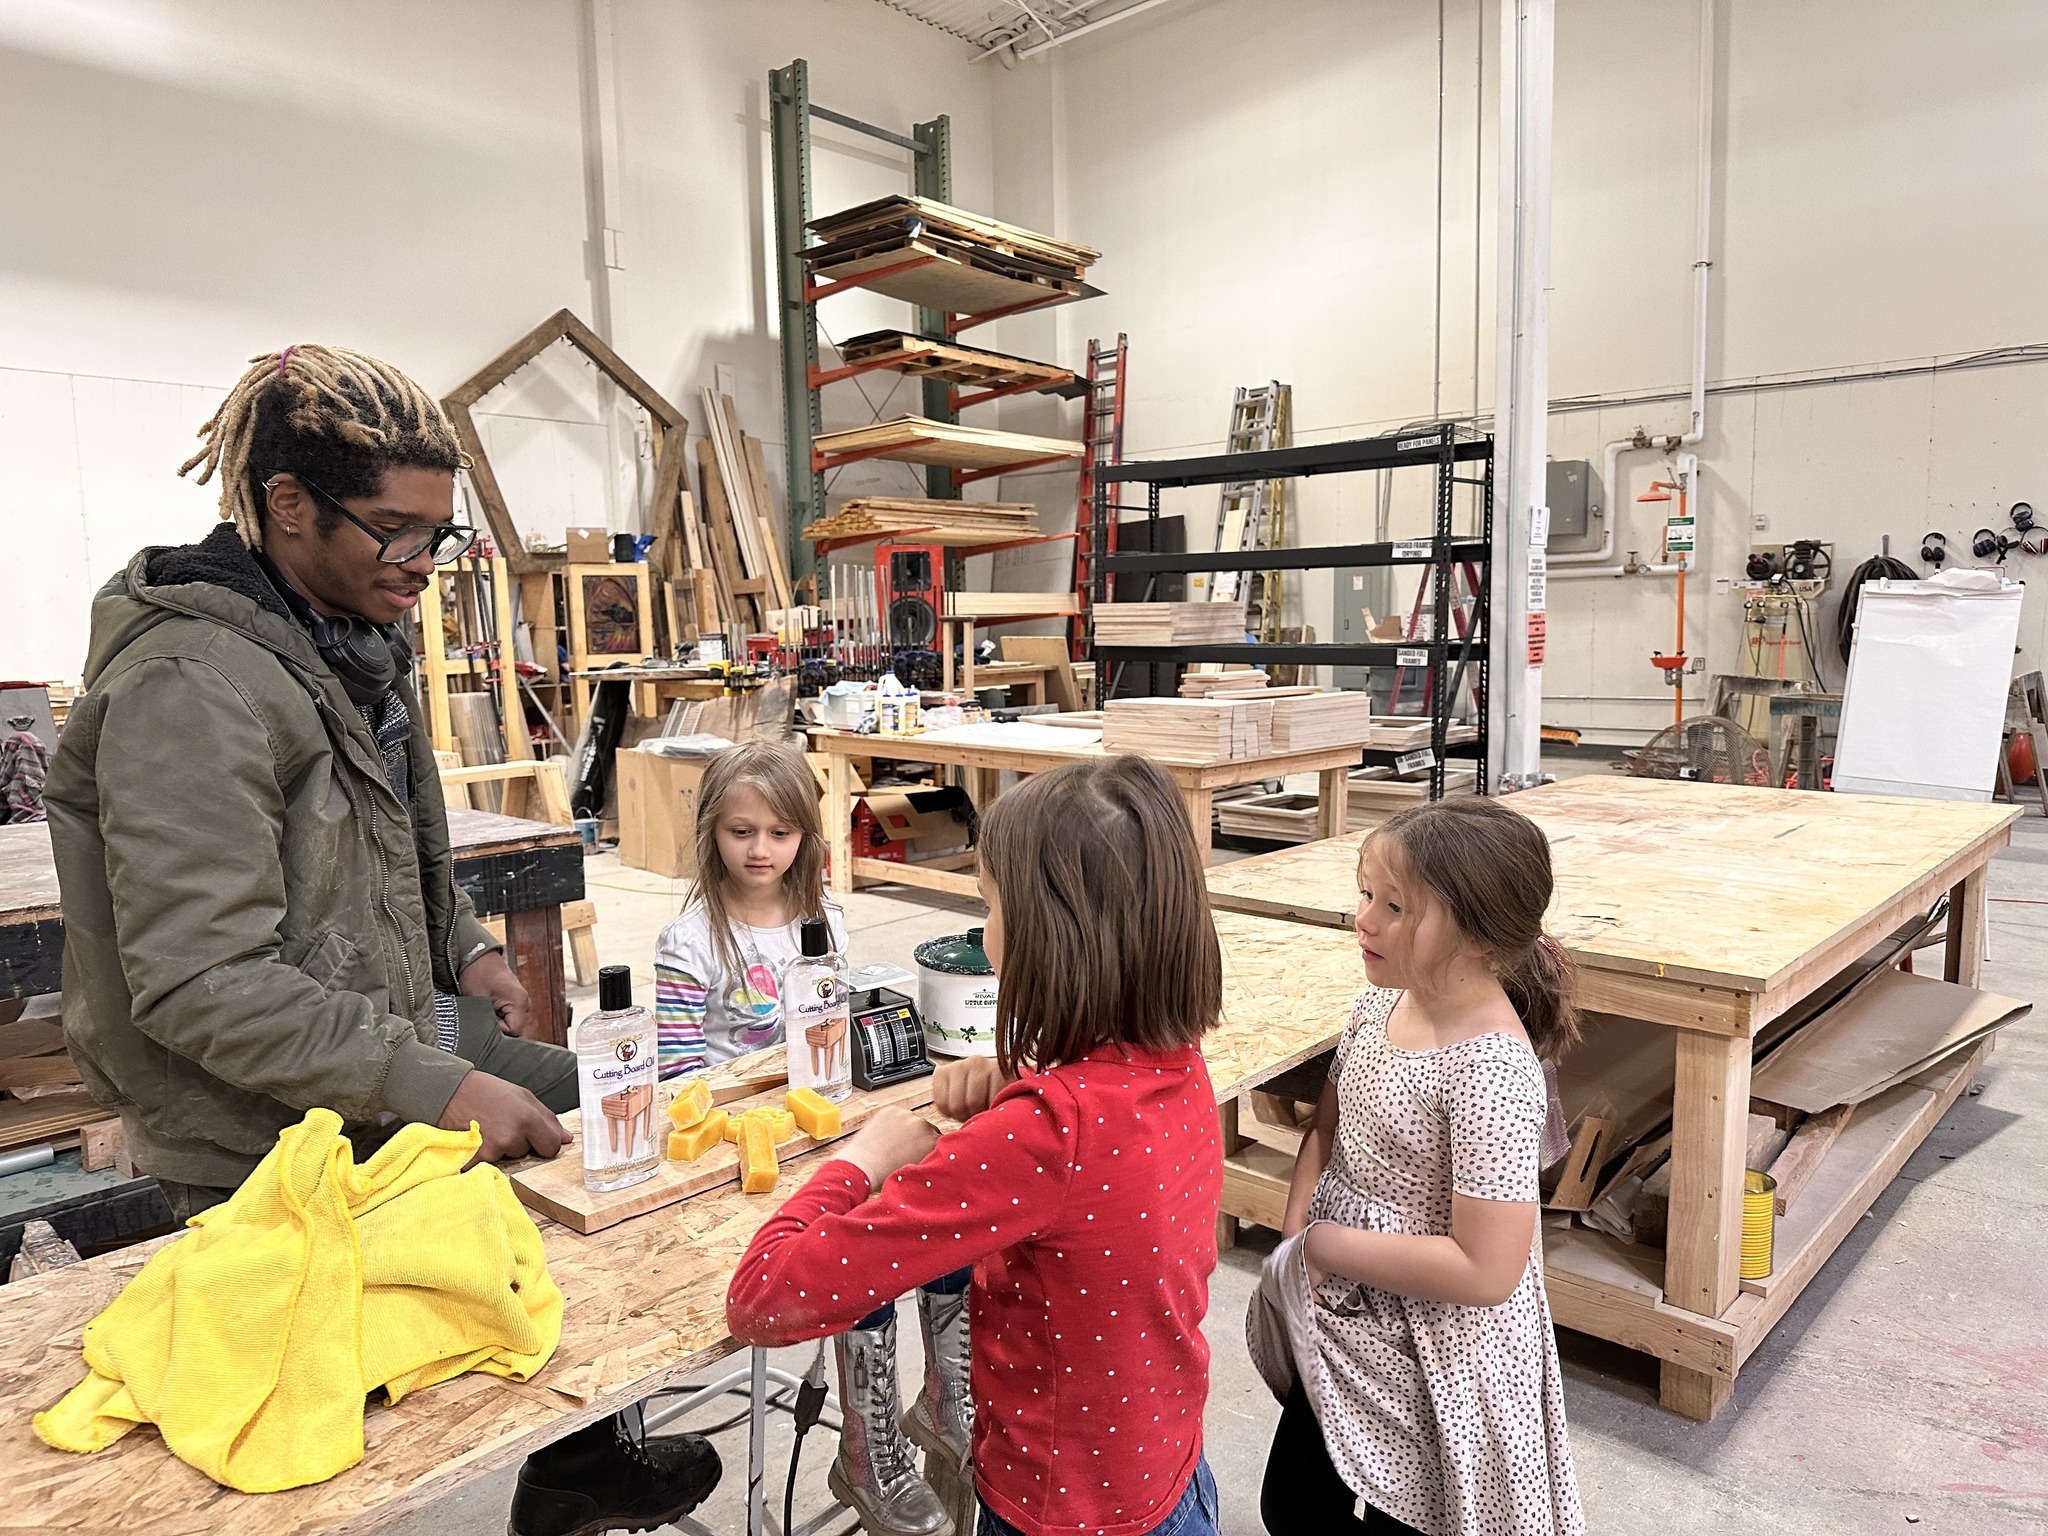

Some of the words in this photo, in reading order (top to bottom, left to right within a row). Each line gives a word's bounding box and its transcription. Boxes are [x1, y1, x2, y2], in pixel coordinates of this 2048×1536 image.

[1398, 440, 1412, 450] READY
[1412, 439, 1421, 448] FOR
[1422, 436, 1440, 446] PANELS
[1413, 541, 1432, 549] FRAMES
[1397, 649, 1416, 657] SANDED
[1416, 650, 1427, 658] FULL
[1402, 657, 1421, 665] FRAMES
[1407, 759, 1426, 770] FRAMES
[798, 1003, 824, 1014] Cutting
[593, 1068, 623, 1080] Cutting
[623, 1060, 645, 1075] Board
